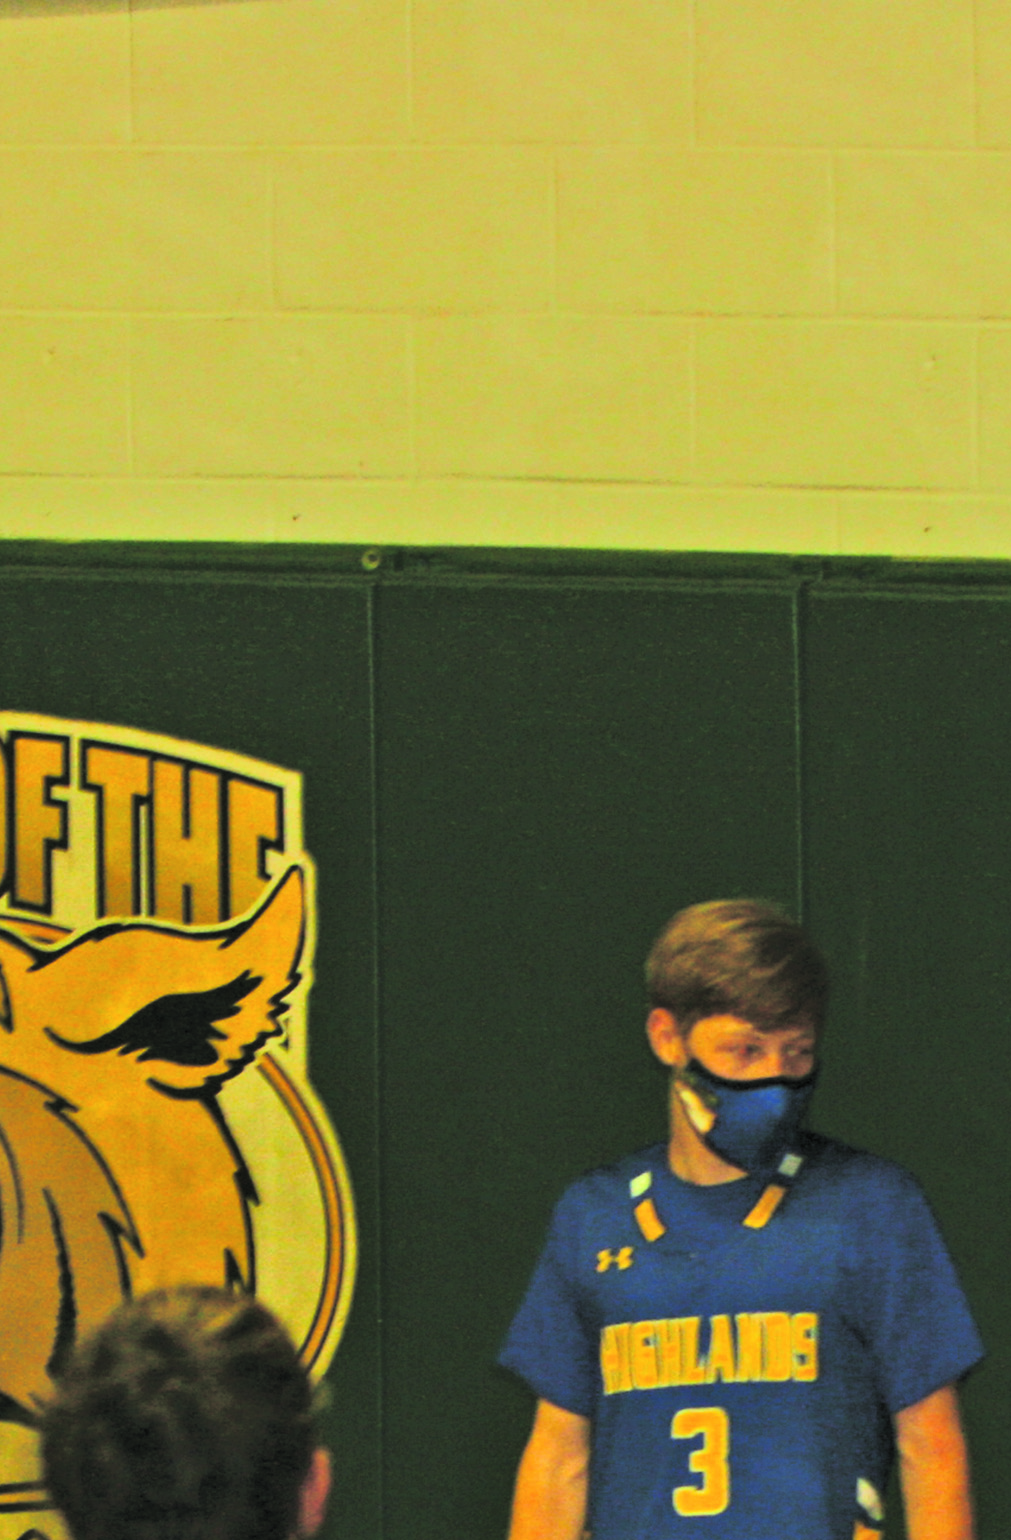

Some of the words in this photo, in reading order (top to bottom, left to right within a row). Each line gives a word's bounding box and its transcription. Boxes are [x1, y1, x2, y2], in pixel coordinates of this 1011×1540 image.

[0, 729, 71, 916] F
[600, 1312, 819, 1395] HIGHLANDS
[670, 1406, 731, 1518] 3
